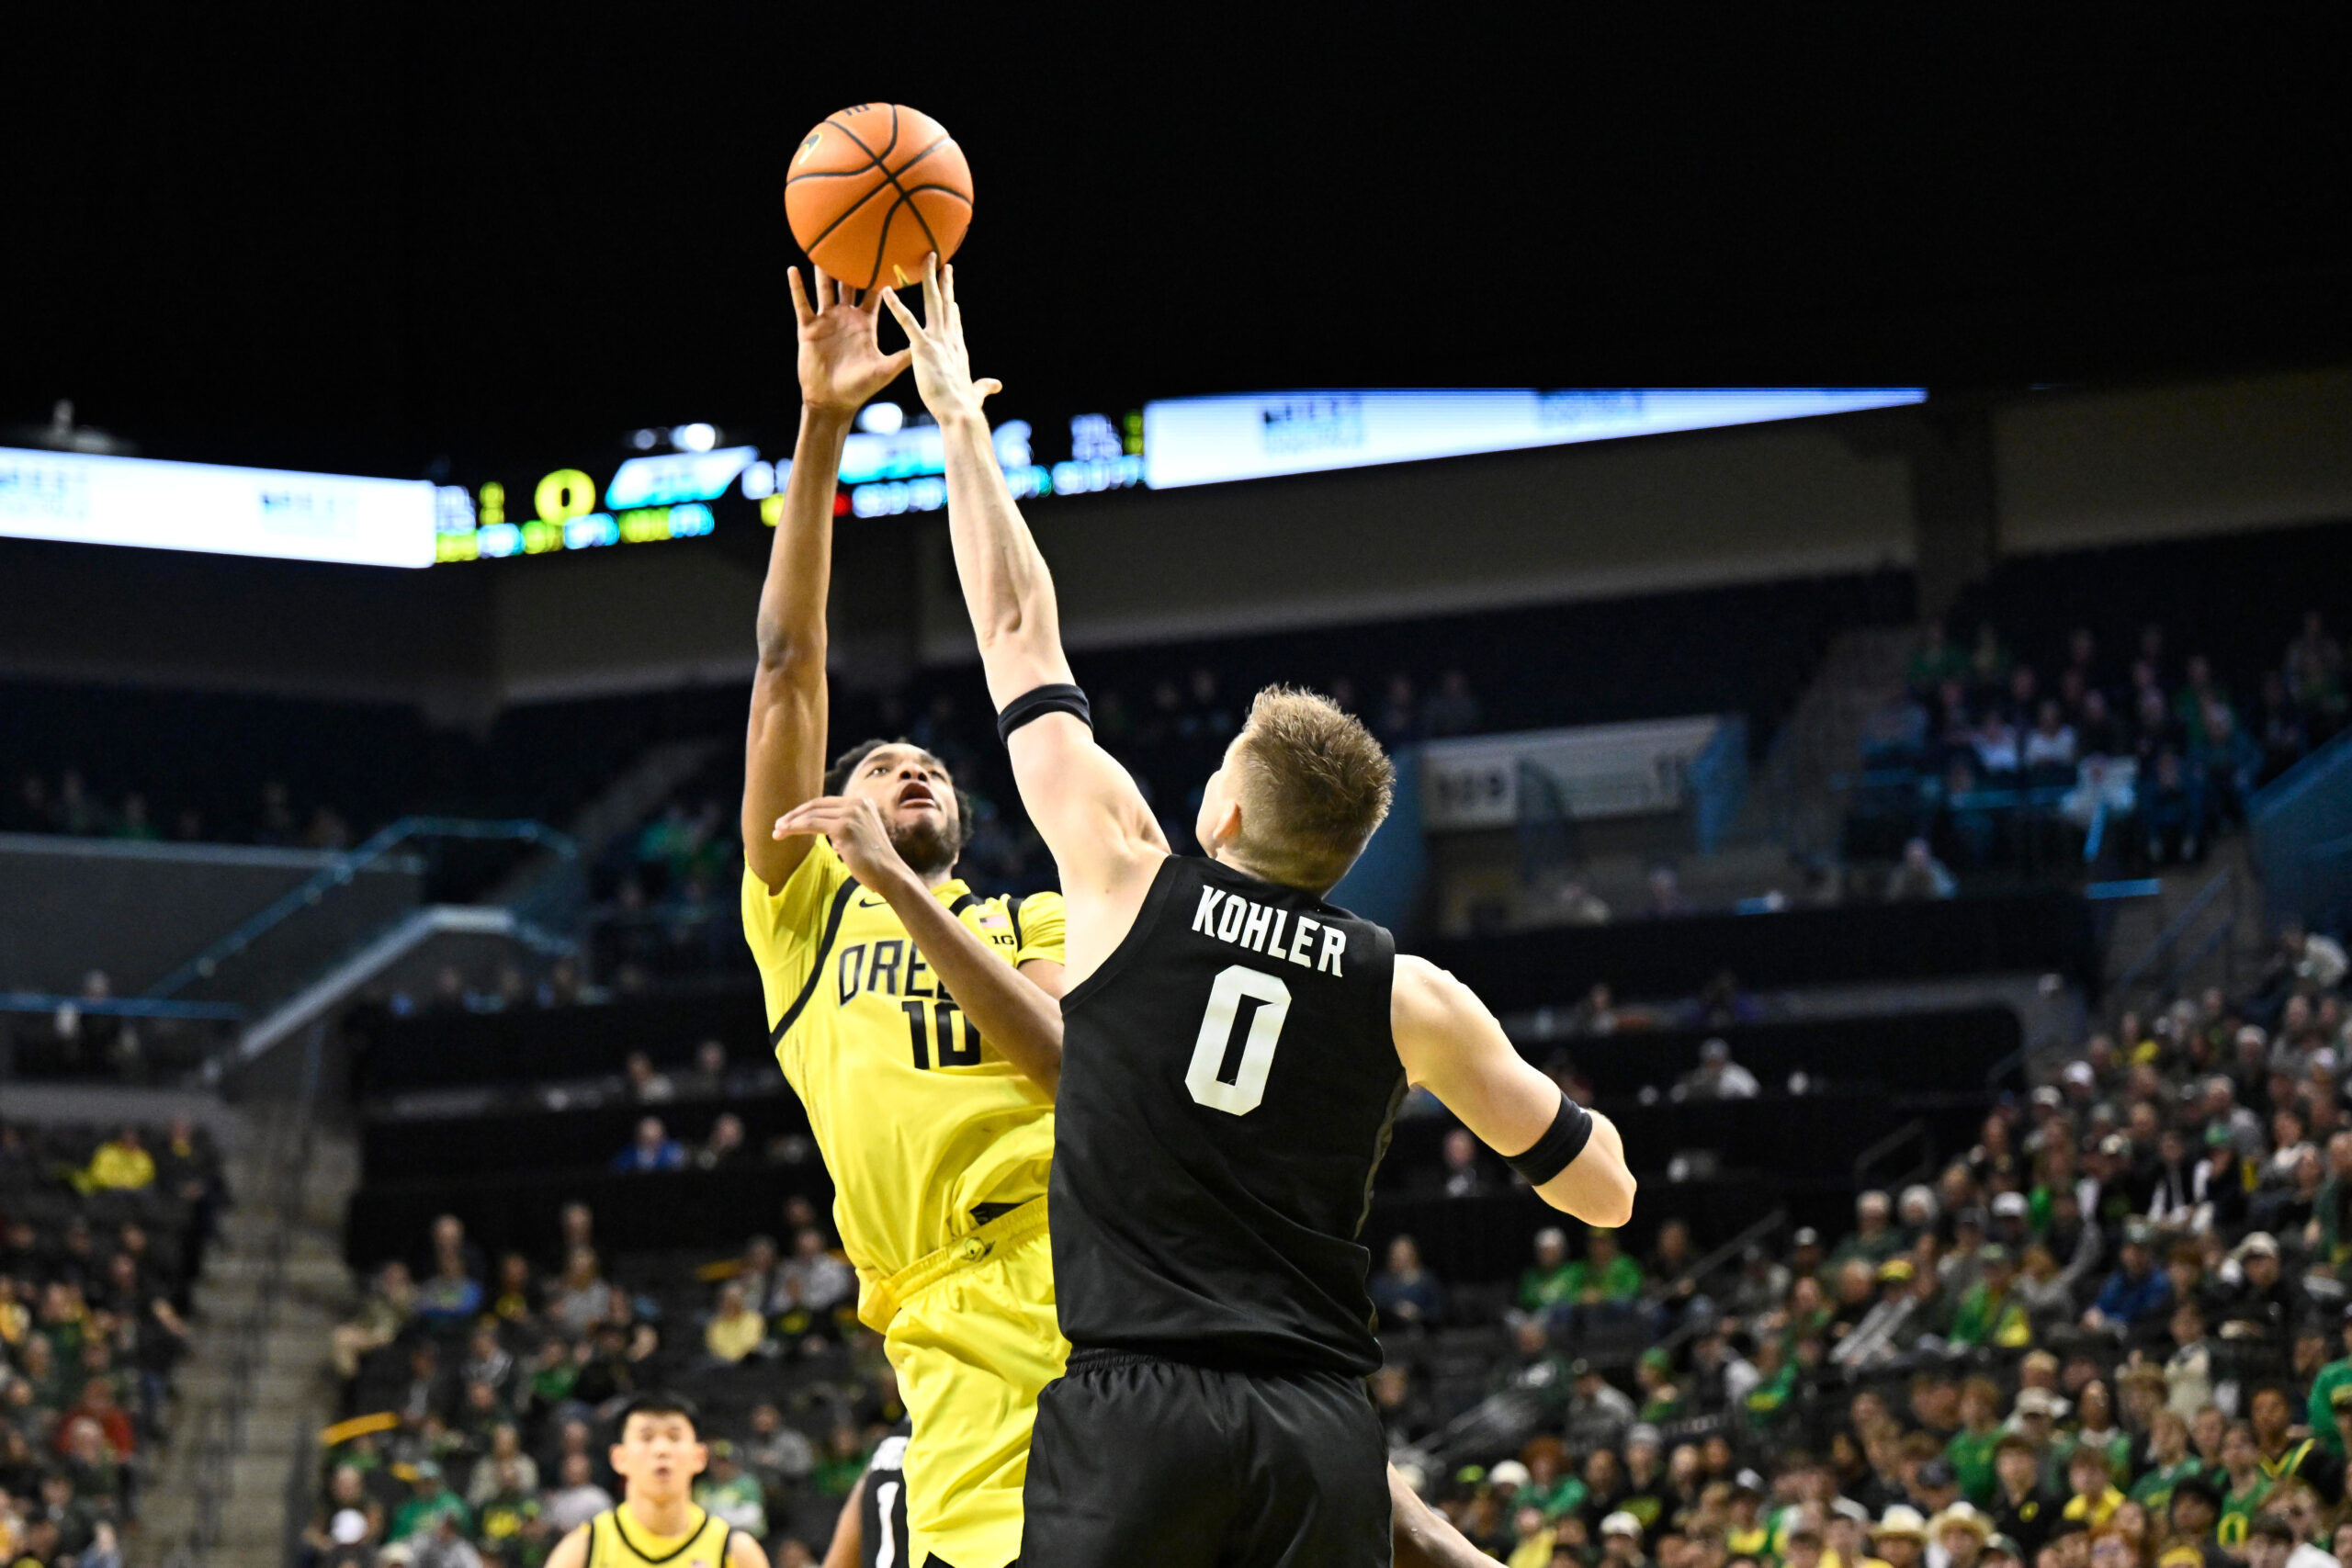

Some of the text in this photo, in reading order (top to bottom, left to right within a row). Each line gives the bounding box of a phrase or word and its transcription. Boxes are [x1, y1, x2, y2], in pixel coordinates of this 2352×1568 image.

[1192, 885, 1347, 978] KOHLER
[838, 940, 956, 1008] ORE
[901, 1000, 981, 1069] 10
[1184, 964, 1293, 1117] 0
